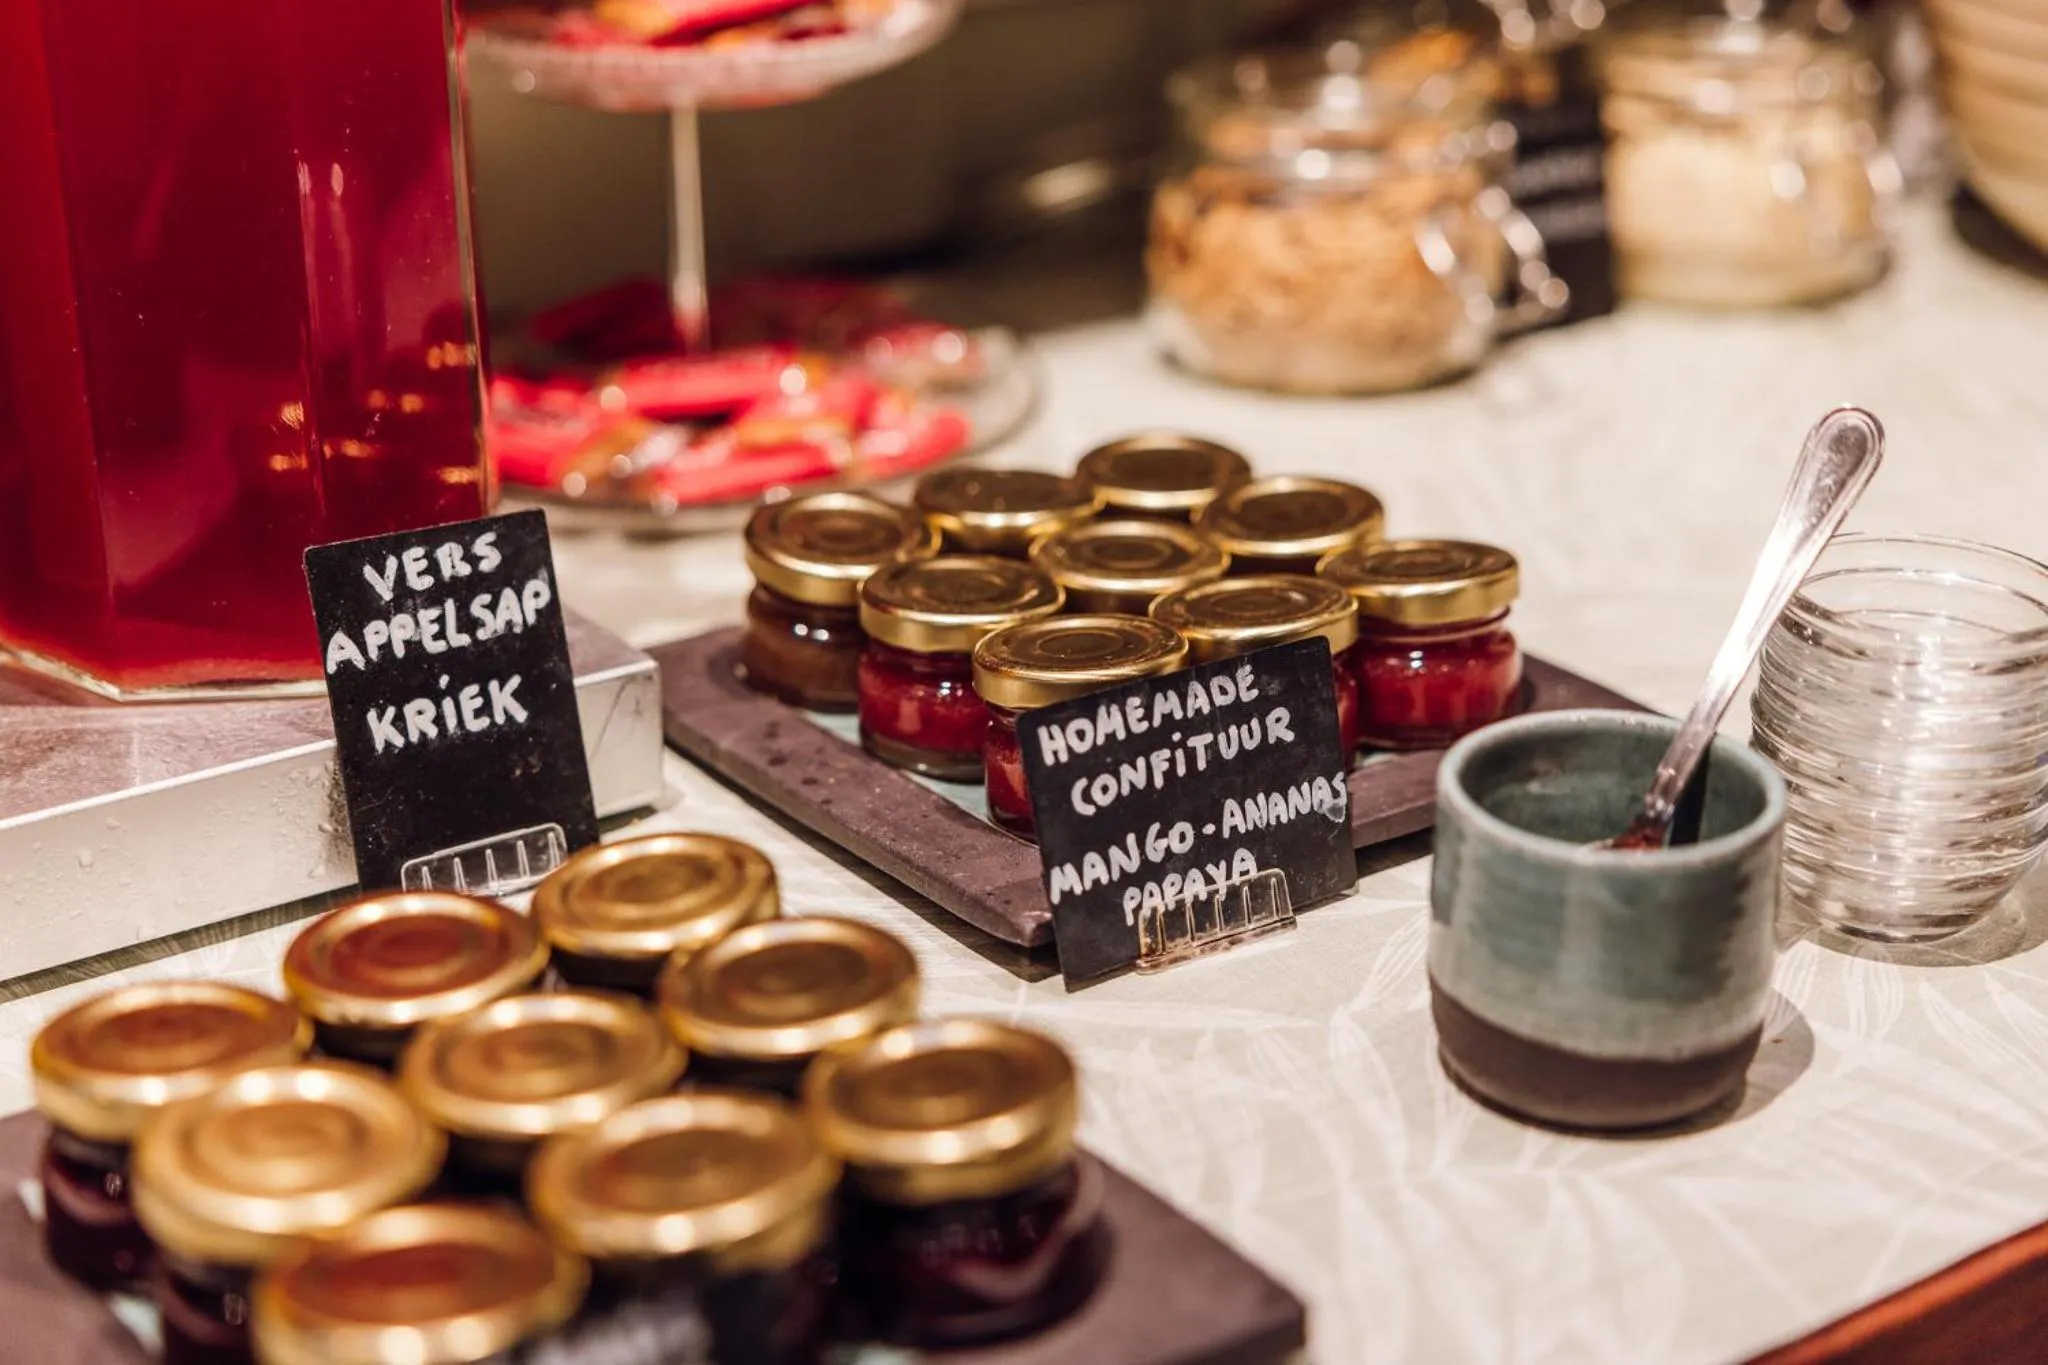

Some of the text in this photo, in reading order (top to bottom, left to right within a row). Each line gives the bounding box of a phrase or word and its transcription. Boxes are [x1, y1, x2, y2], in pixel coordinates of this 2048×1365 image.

[363, 532, 501, 601] VERS
[326, 579, 551, 674] APPELSAP
[1037, 665, 1259, 766] HOMEMADE
[1123, 848, 1258, 926] PAPAYA
